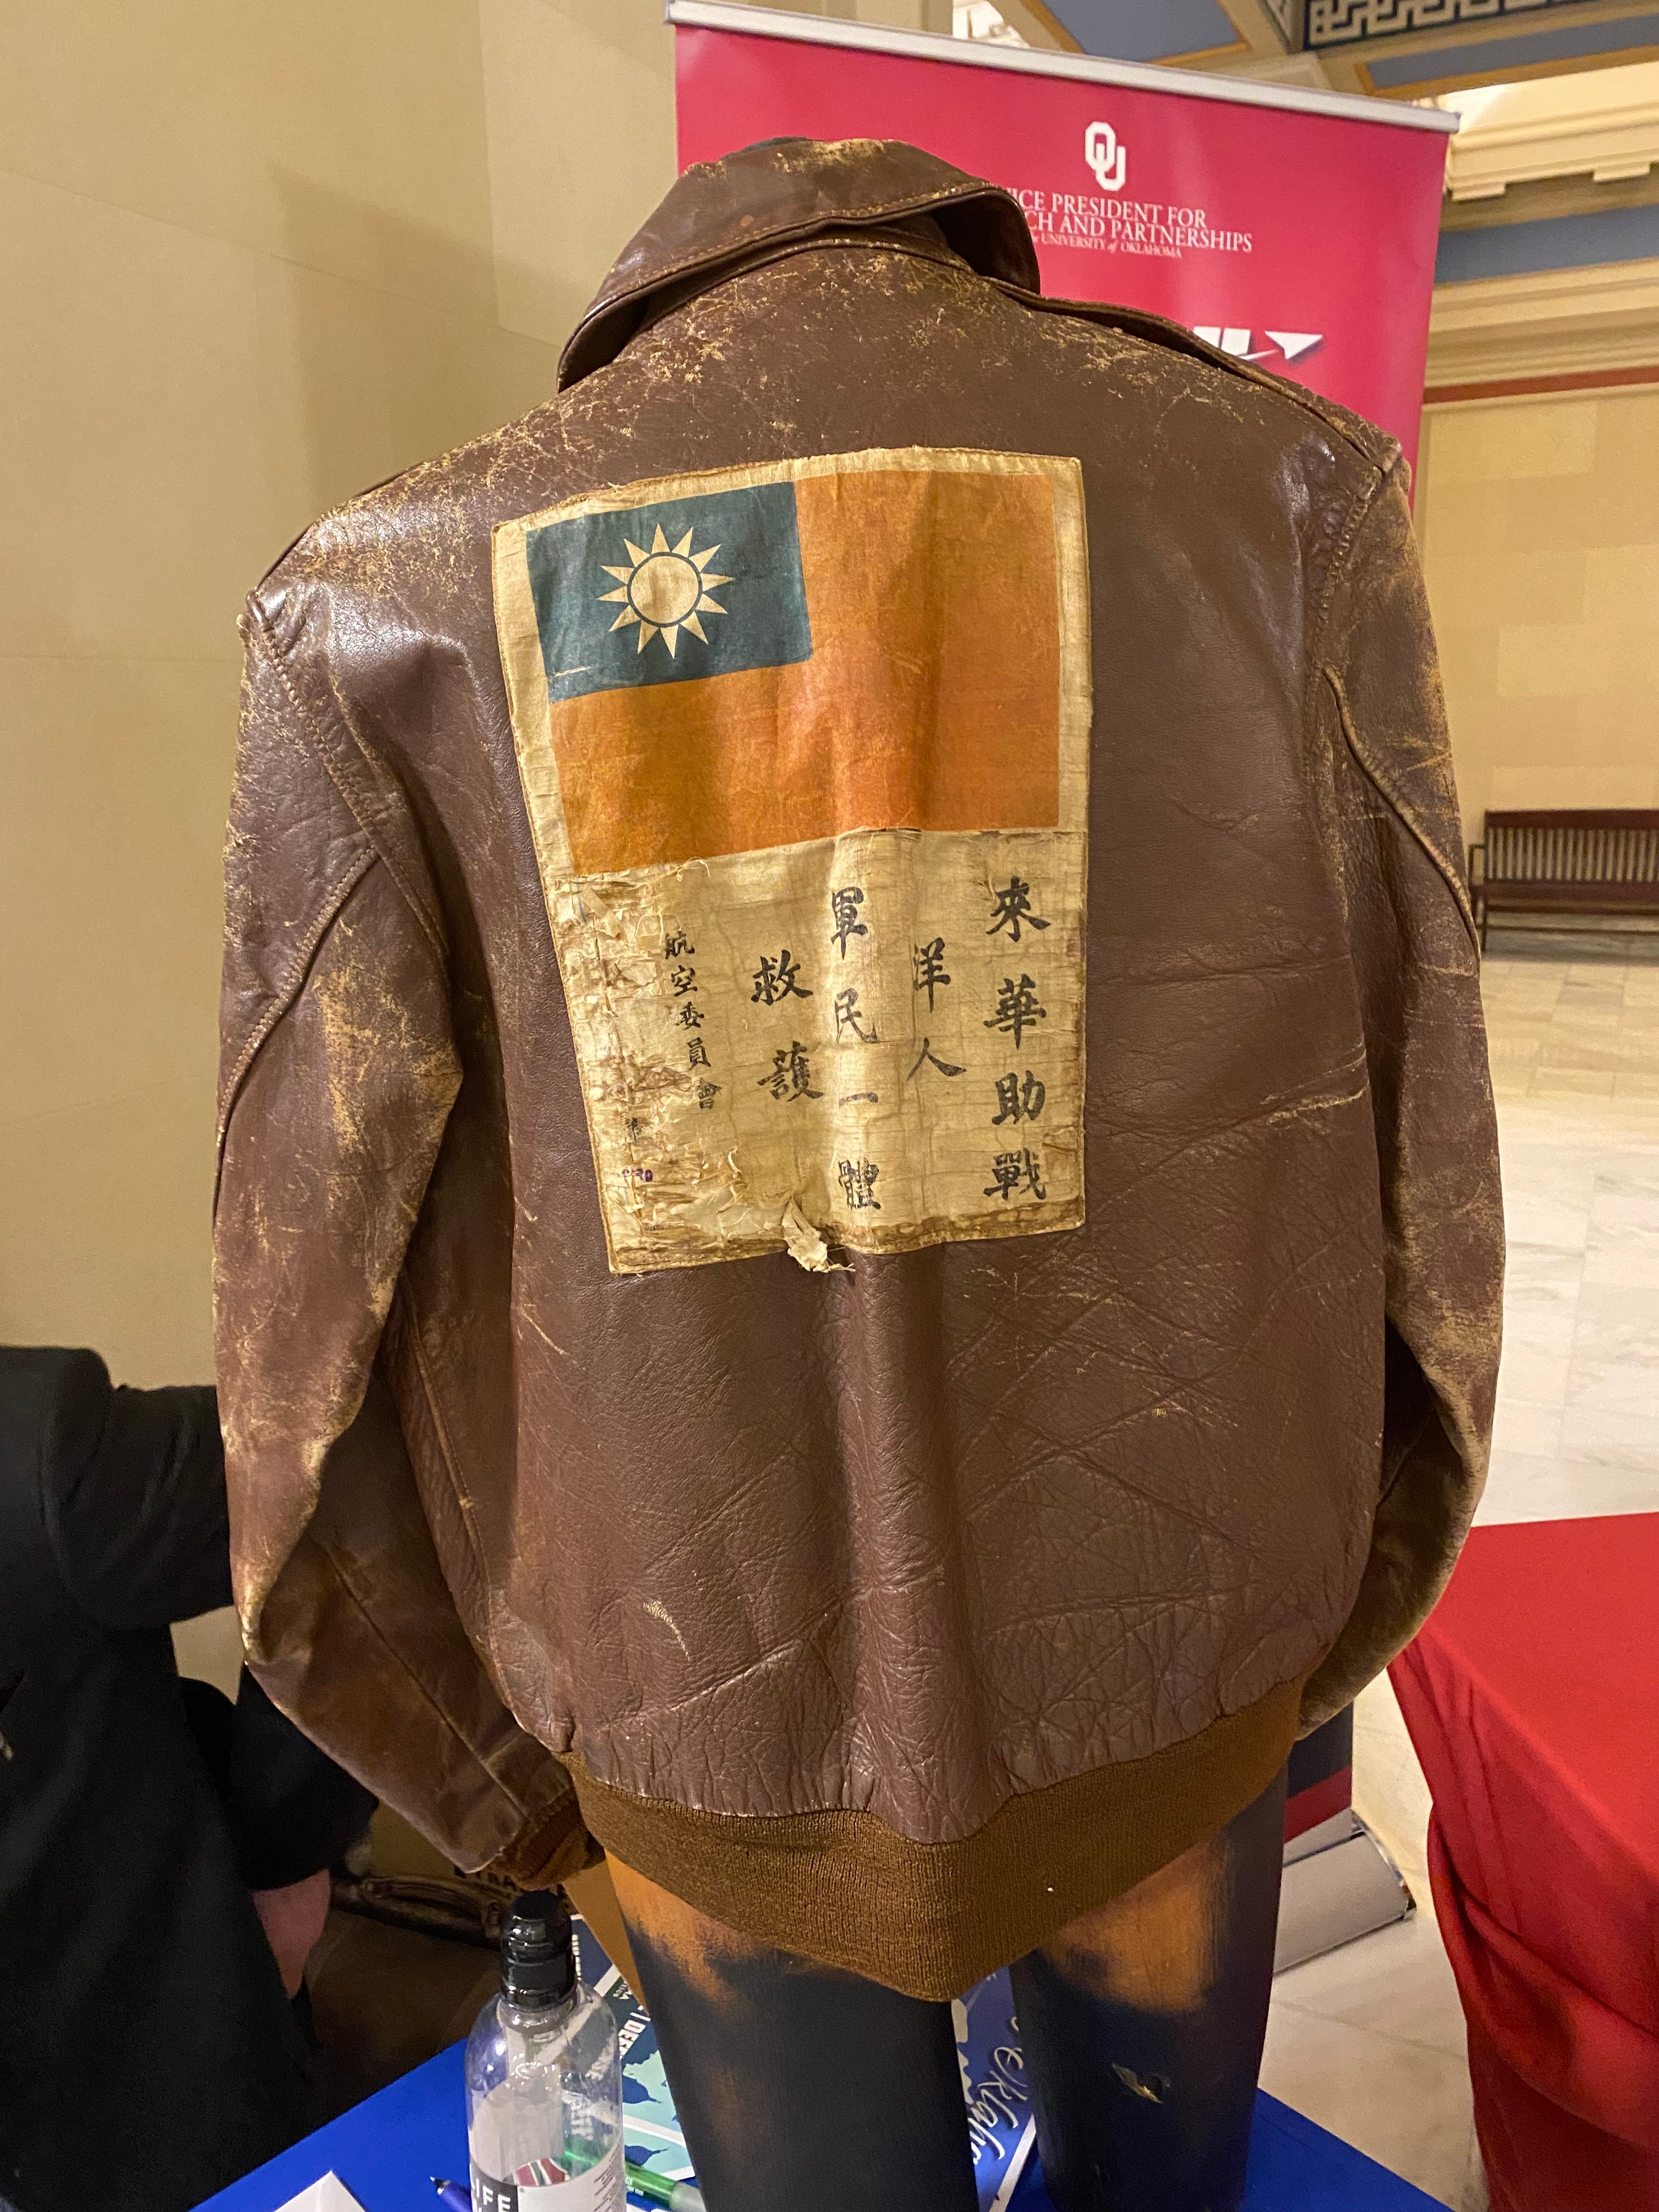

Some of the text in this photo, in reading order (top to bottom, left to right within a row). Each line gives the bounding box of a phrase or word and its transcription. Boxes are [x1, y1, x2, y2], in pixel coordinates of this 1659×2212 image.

[1041, 232, 1105, 250] UNIVERSITY
[1120, 241, 1182, 258] OKLAHOMA
[1052, 193, 1163, 224] PRESIDENT
[1168, 206, 1206, 228] FOR
[1059, 215, 1105, 236] AND
[1111, 218, 1252, 252] PARTNERSHIPS
[665, 930, 723, 1110] 航空委員會
[751, 949, 823, 1103] 救護
[831, 887, 881, 1210] 軍民一體
[908, 937, 967, 1080] 洋人
[984, 876, 1051, 1200] 來華助戰
